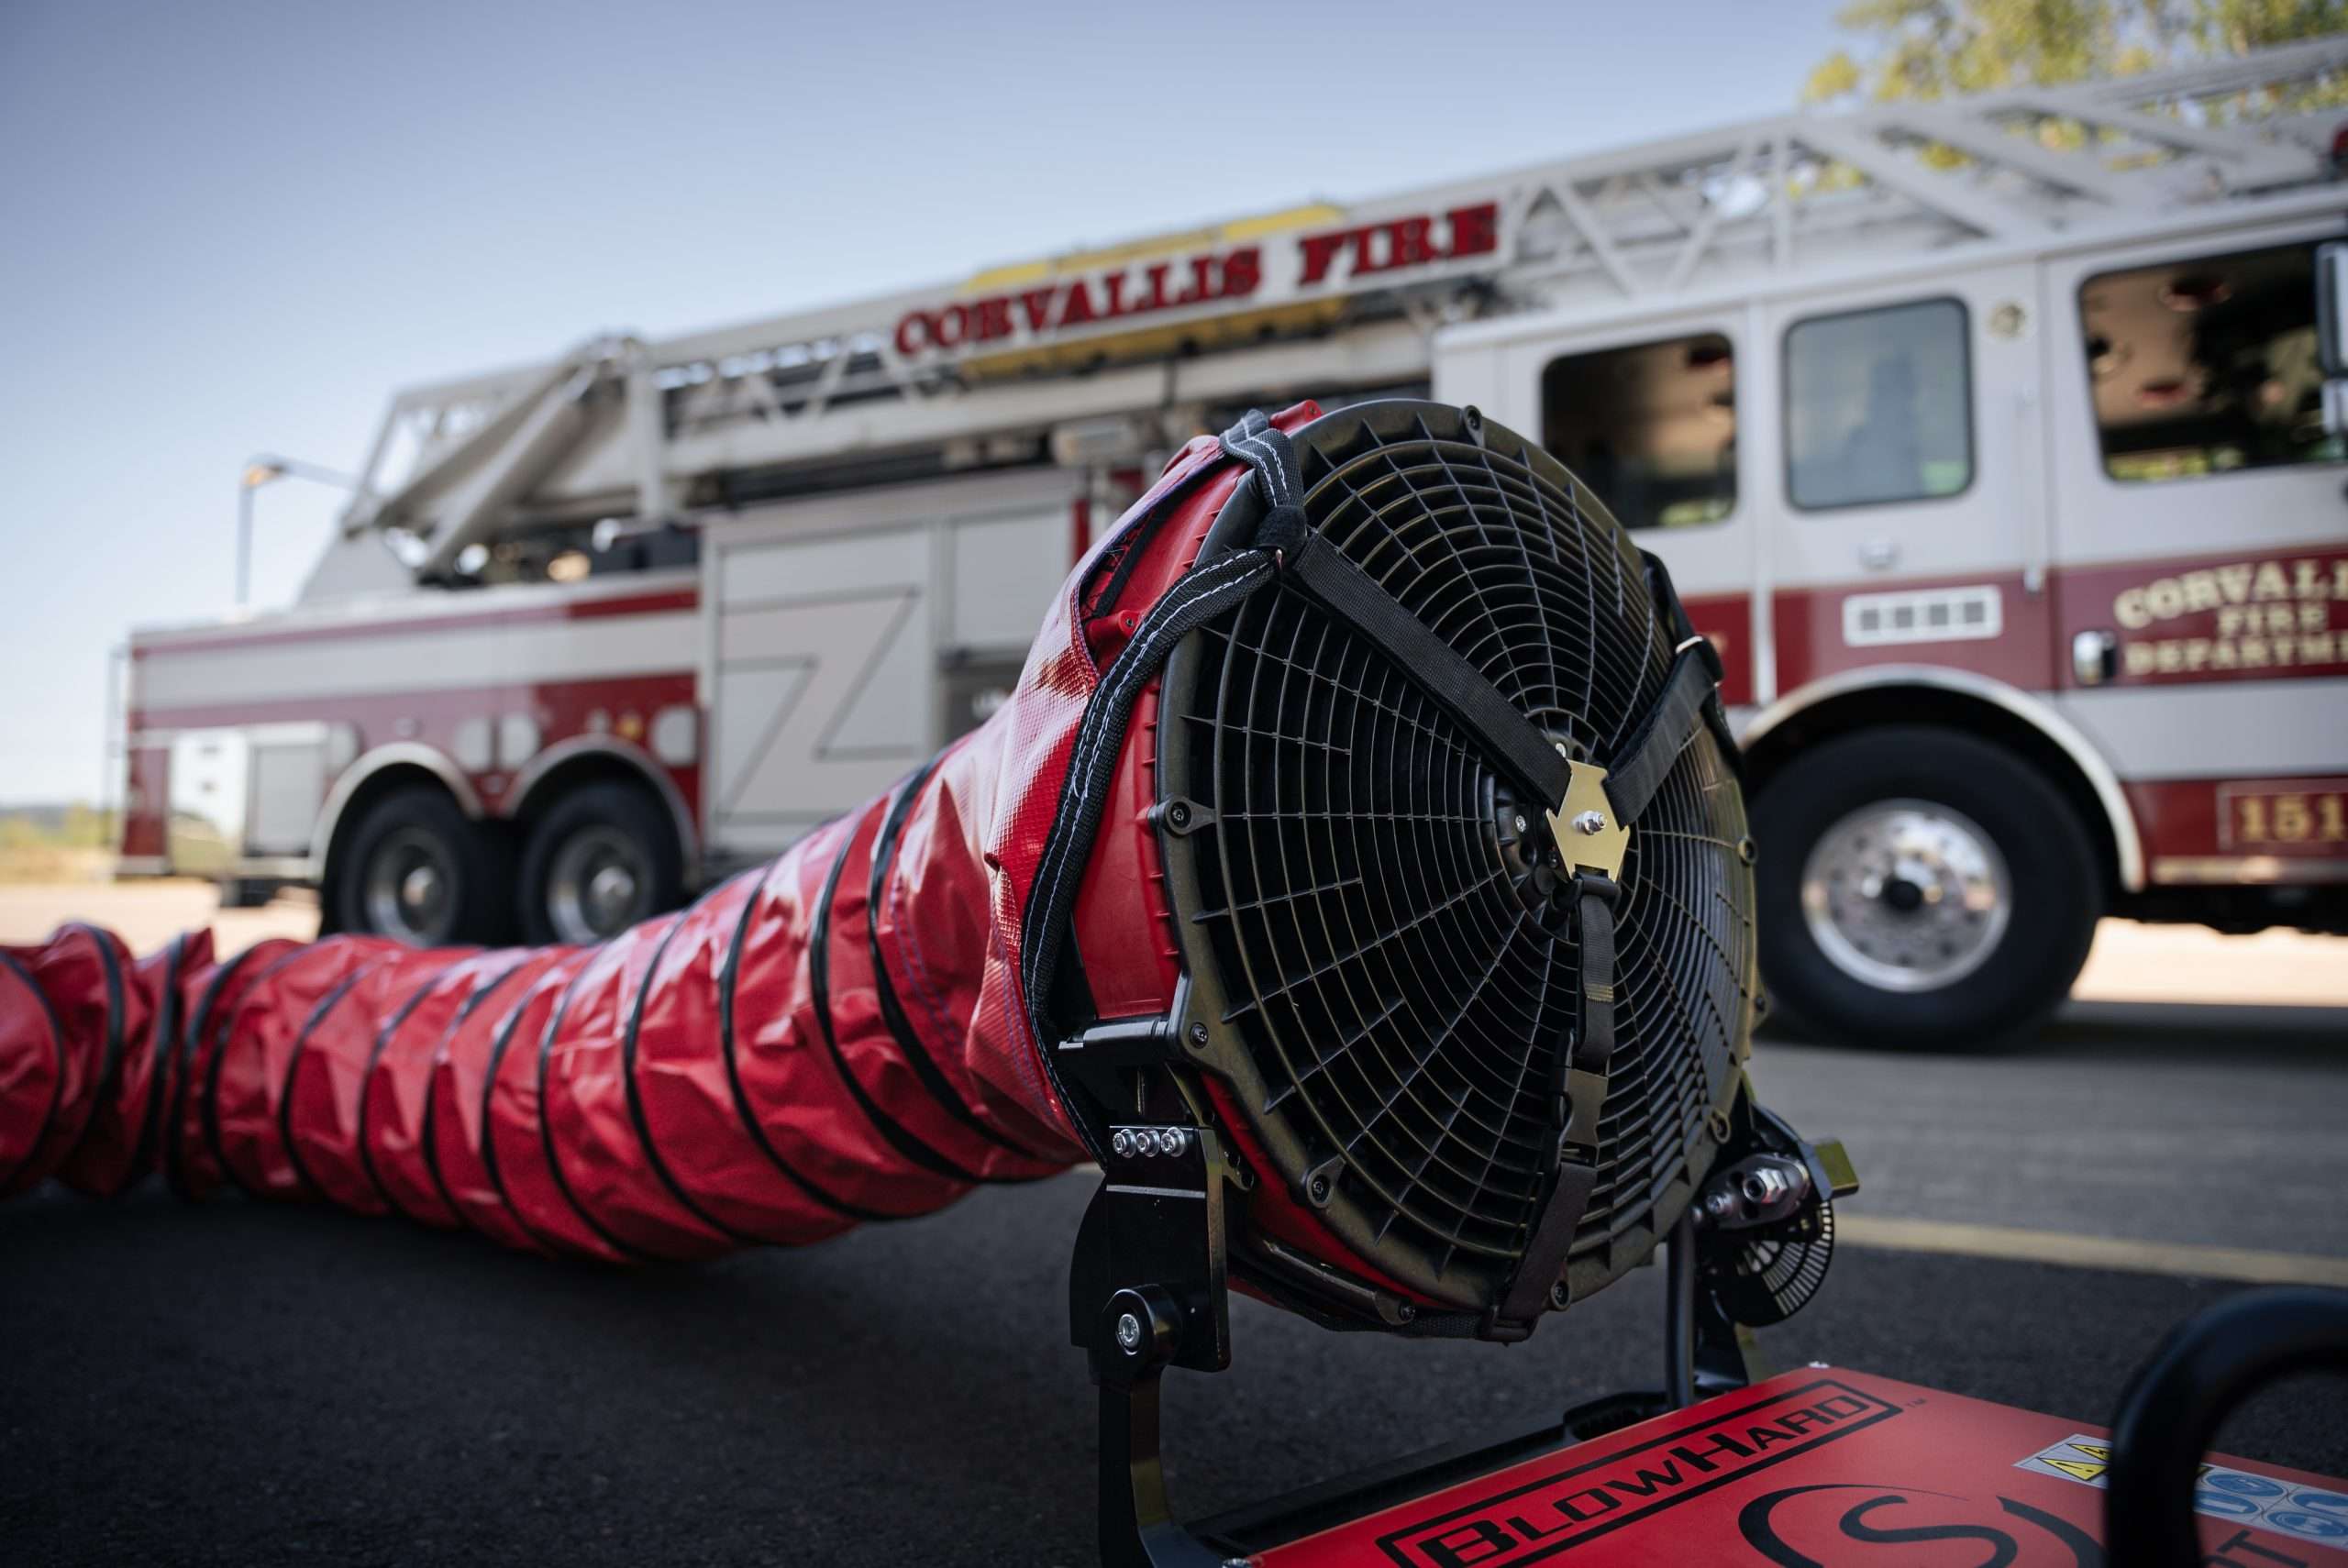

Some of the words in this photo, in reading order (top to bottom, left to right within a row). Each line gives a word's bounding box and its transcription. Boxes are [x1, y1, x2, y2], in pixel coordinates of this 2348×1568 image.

[895, 245, 1262, 356] CORVALLIS
[1298, 202, 1498, 286] FIRE
[2217, 602, 2328, 637] FIRE
[2124, 629, 2348, 676] DEPARTM
[2241, 792, 2346, 844] 151
